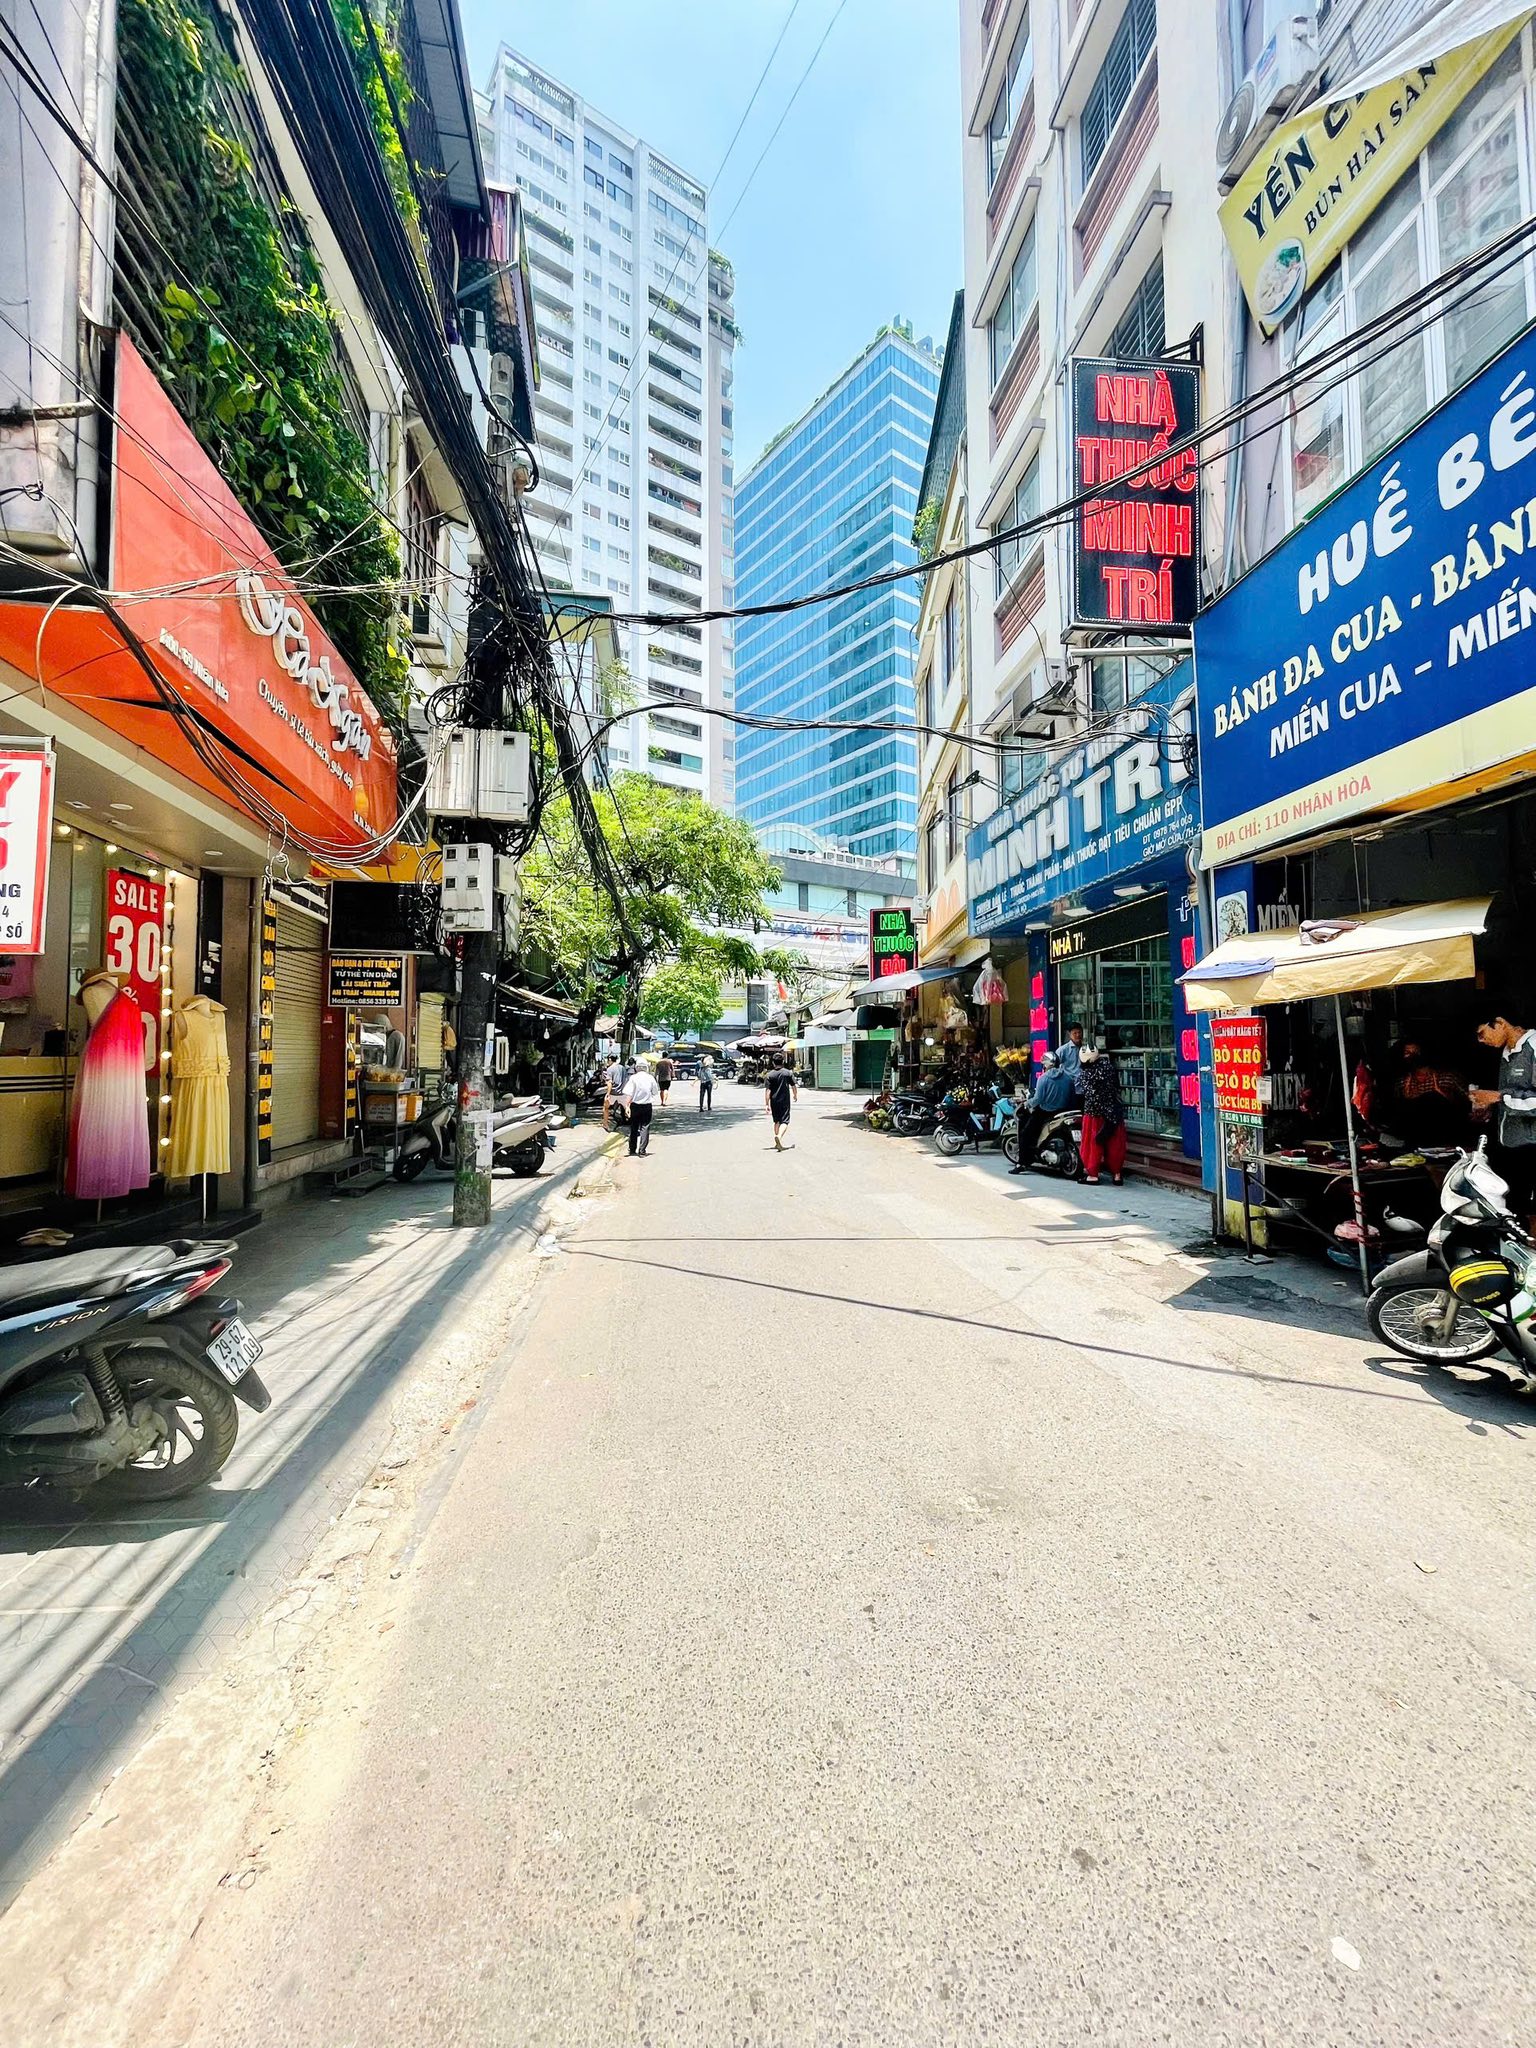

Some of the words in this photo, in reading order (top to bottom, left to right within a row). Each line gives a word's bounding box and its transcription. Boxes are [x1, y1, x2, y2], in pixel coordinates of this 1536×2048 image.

[1303, 176, 1343, 235] BÚN
[1346, 122, 1386, 182] HẢI
[1389, 58, 1438, 127] SẢN
[1243, 133, 1318, 240] YẾN
[1096, 370, 1177, 427] NHÀ
[1077, 426, 1197, 492] THUỐC
[1299, 461, 1413, 615] HUẾ
[1437, 371, 1536, 510] BÉ
[1084, 500, 1192, 556] MINH
[1103, 559, 1173, 622] TRÍ
[1214, 669, 1278, 738] BÁNH
[1283, 644, 1324, 695] ĐA
[1330, 594, 1403, 664] CUA
[1269, 694, 1330, 758] MIẾN
[1339, 662, 1402, 720] CUA
[986, 803, 1015, 844] NHÀ
[1013, 766, 1060, 823] THUỐC
[1076, 838, 1097, 864] THUỐC
[1098, 832, 1113, 853] ĐẠT
[1113, 822, 1131, 844] TIÊU
[1133, 802, 1162, 835] CHUẨN
[1164, 795, 1182, 819] GPP
[1216, 831, 1236, 850] ĐỊA
[1238, 817, 1261, 841] CHỈ:
[1265, 808, 1289, 831] 110
[1293, 790, 1333, 820] NHÂN
[1337, 774, 1371, 803] HÒA
[967, 796, 1070, 900] MINH
[114, 879, 159, 914] SALE
[880, 910, 906, 931] NHÀ
[107, 914, 161, 984] 30
[873, 929, 914, 953] THUỐC
[1053, 930, 1072, 958] NHÀ
[362, 969, 374, 978] TÍN
[375, 971, 397, 980] DỤNG
[1214, 1043, 1231, 1064] BÒ
[1233, 1043, 1262, 1065] KHÔ
[1216, 1069, 1239, 1089] GIÒ
[34, 1305, 110, 1333] VISION
